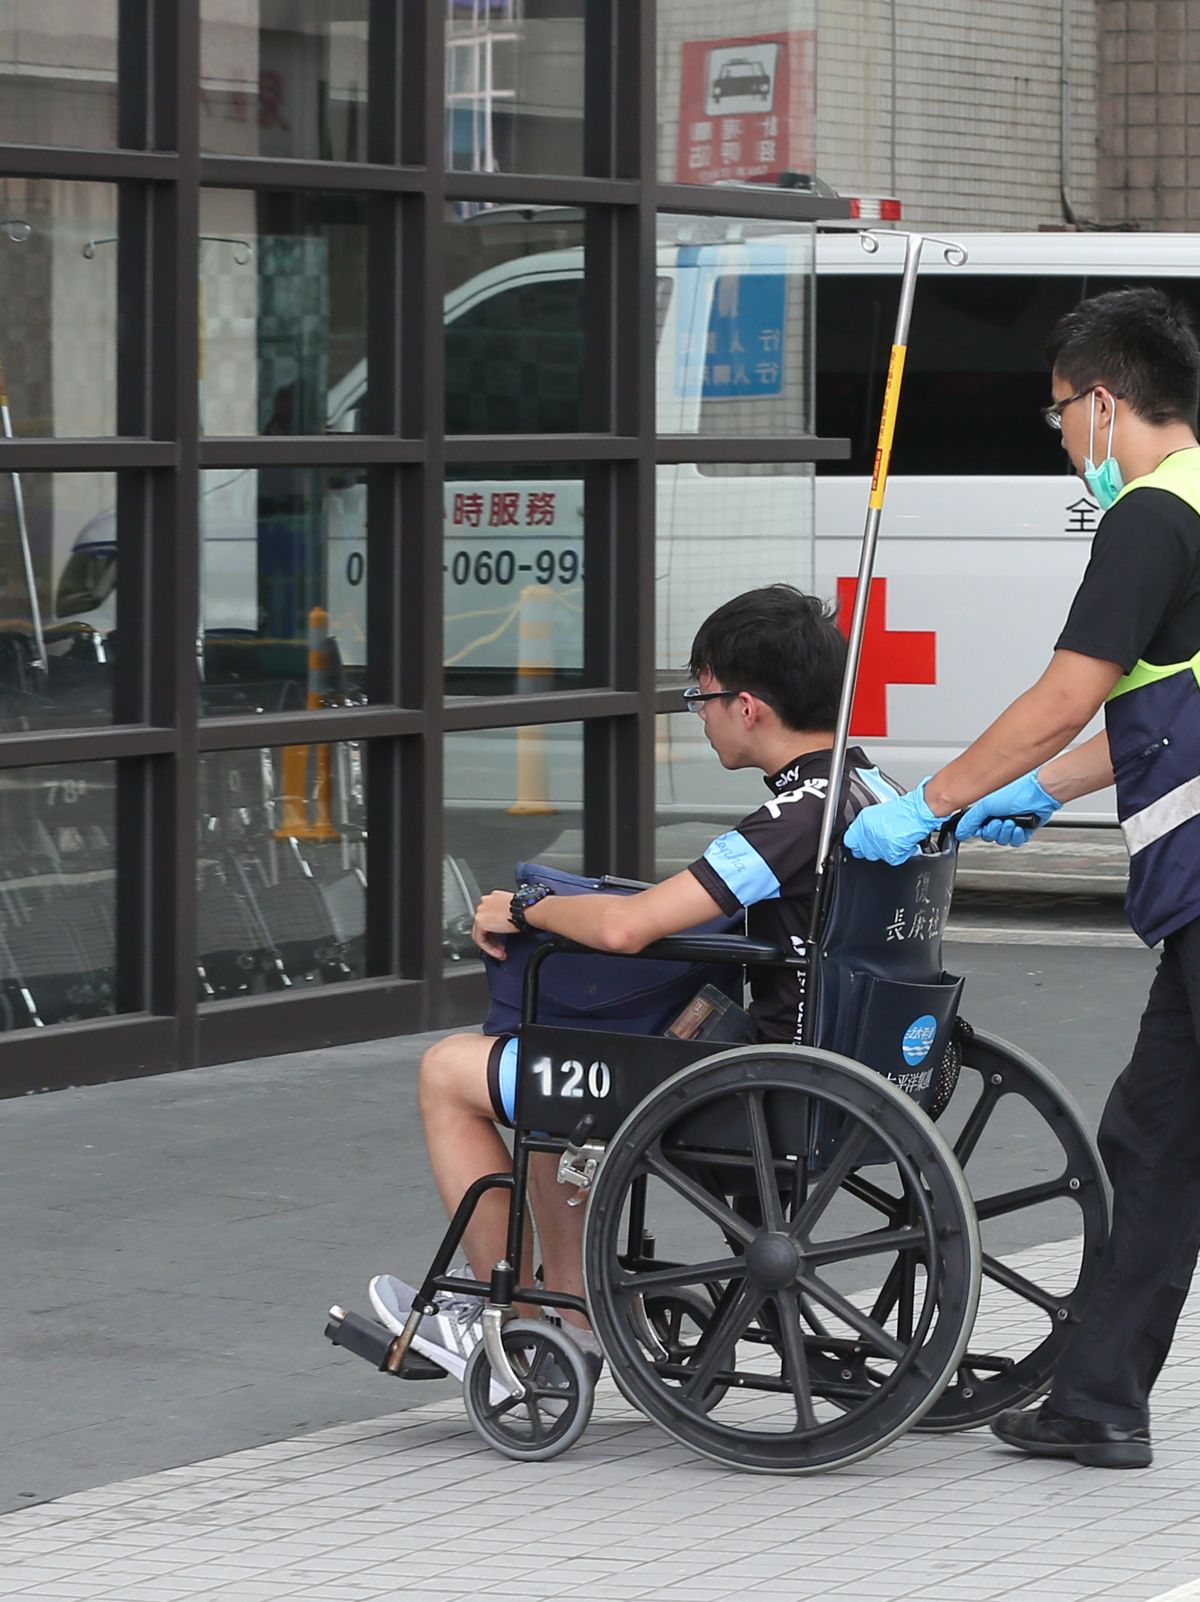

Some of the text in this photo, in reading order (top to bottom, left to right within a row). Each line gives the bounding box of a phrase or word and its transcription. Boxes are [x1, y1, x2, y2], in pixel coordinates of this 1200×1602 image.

[443, 492, 556, 527] 時服務
[532, 1055, 611, 1099] 120
